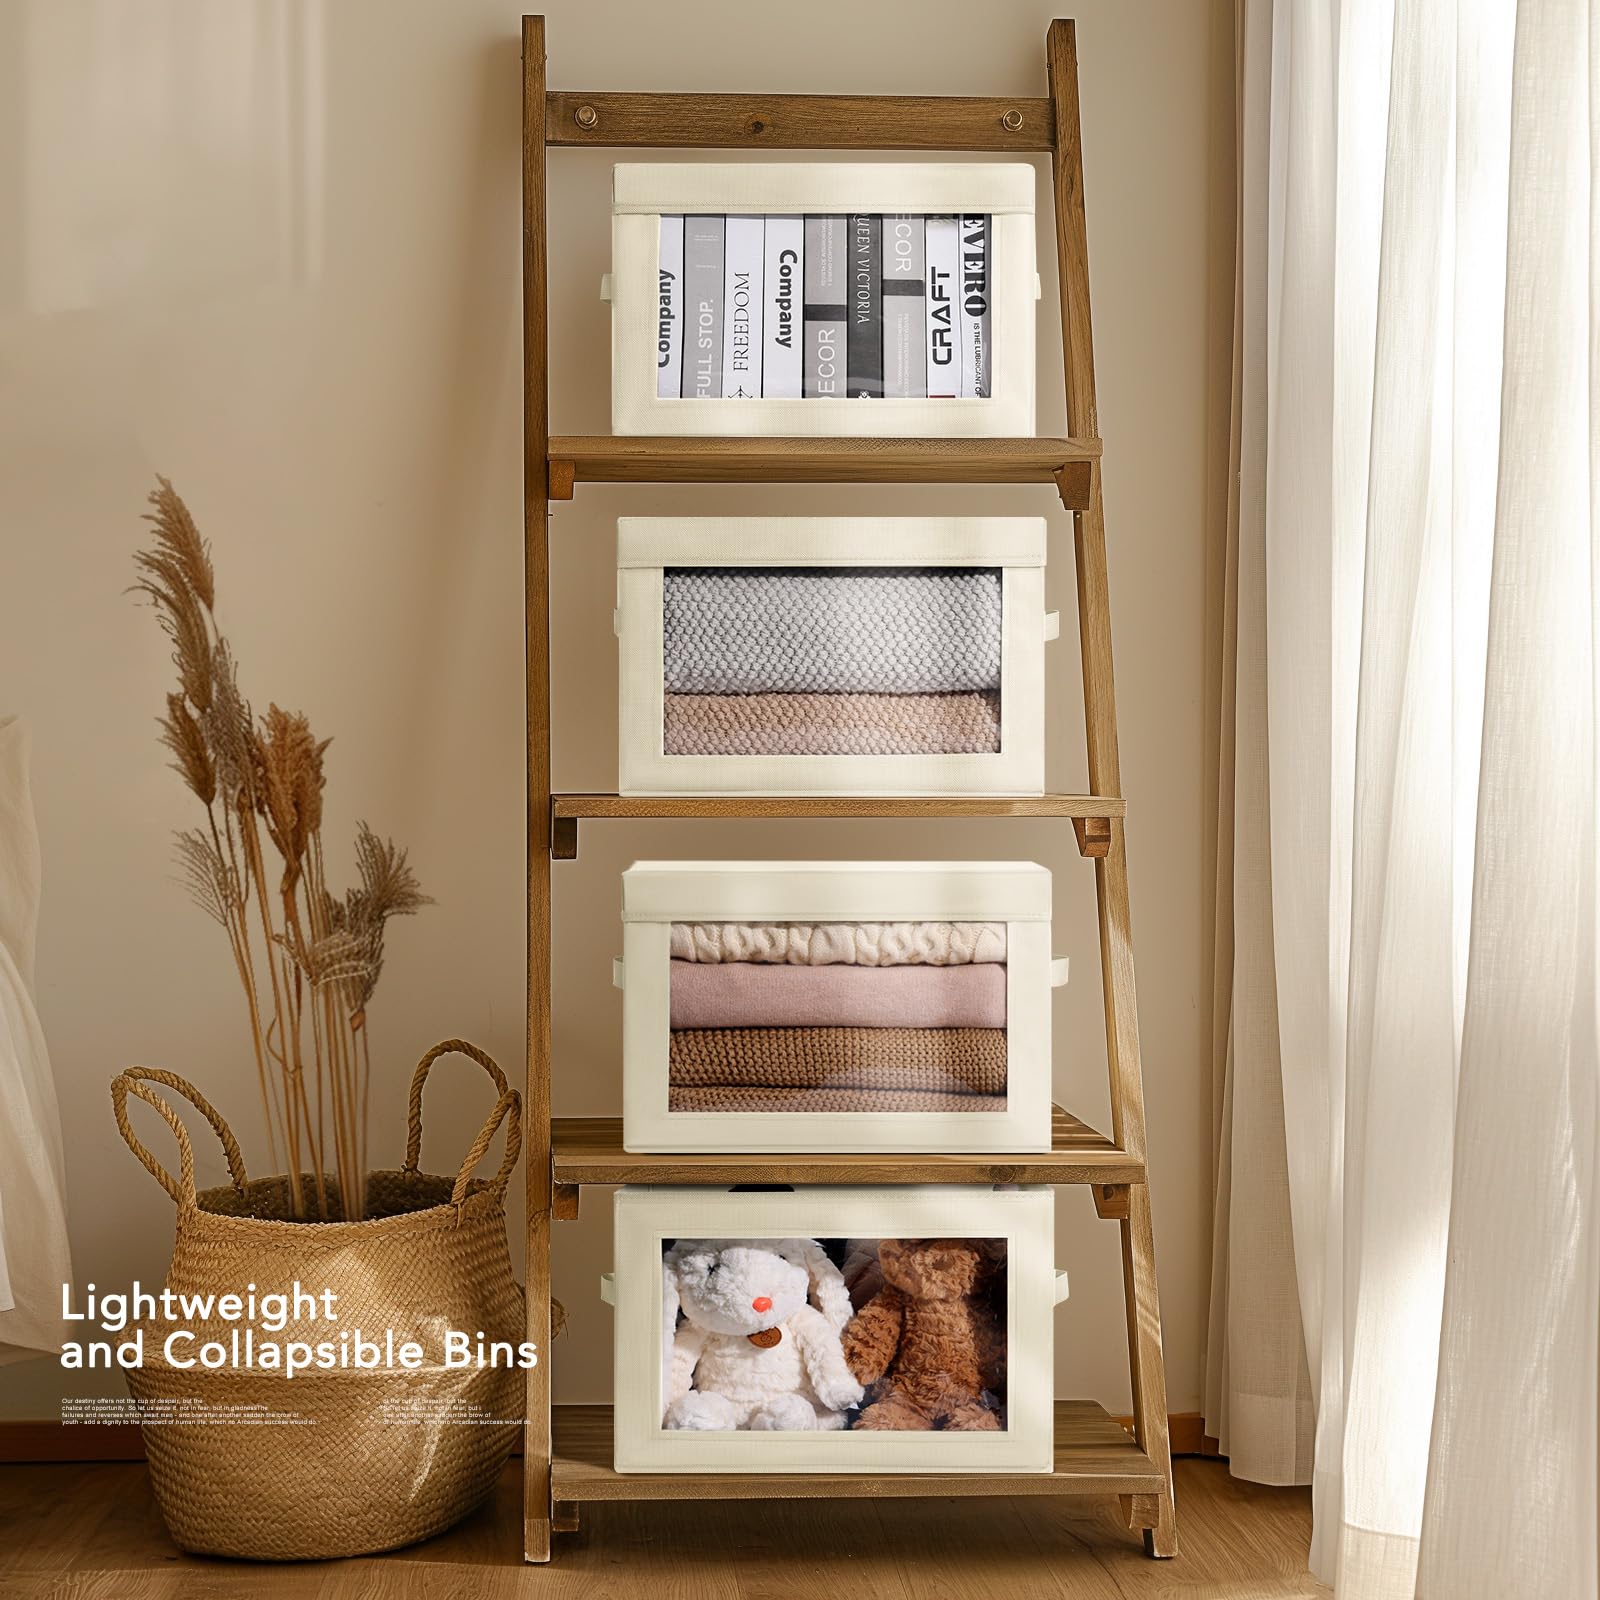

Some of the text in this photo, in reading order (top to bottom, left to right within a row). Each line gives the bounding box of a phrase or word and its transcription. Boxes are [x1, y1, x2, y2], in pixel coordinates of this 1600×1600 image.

[732, 271, 750, 372] FREEDOM
[775, 249, 798, 349] Company
[857, 258, 871, 324] VICTORIA
[931, 266, 953, 366] CRAFT
[696, 298, 714, 398] FULL STOP.
[818, 328, 836, 398] ECOR
[973, 331, 982, 345] THE
[973, 345, 982, 385] LUBRICANT
